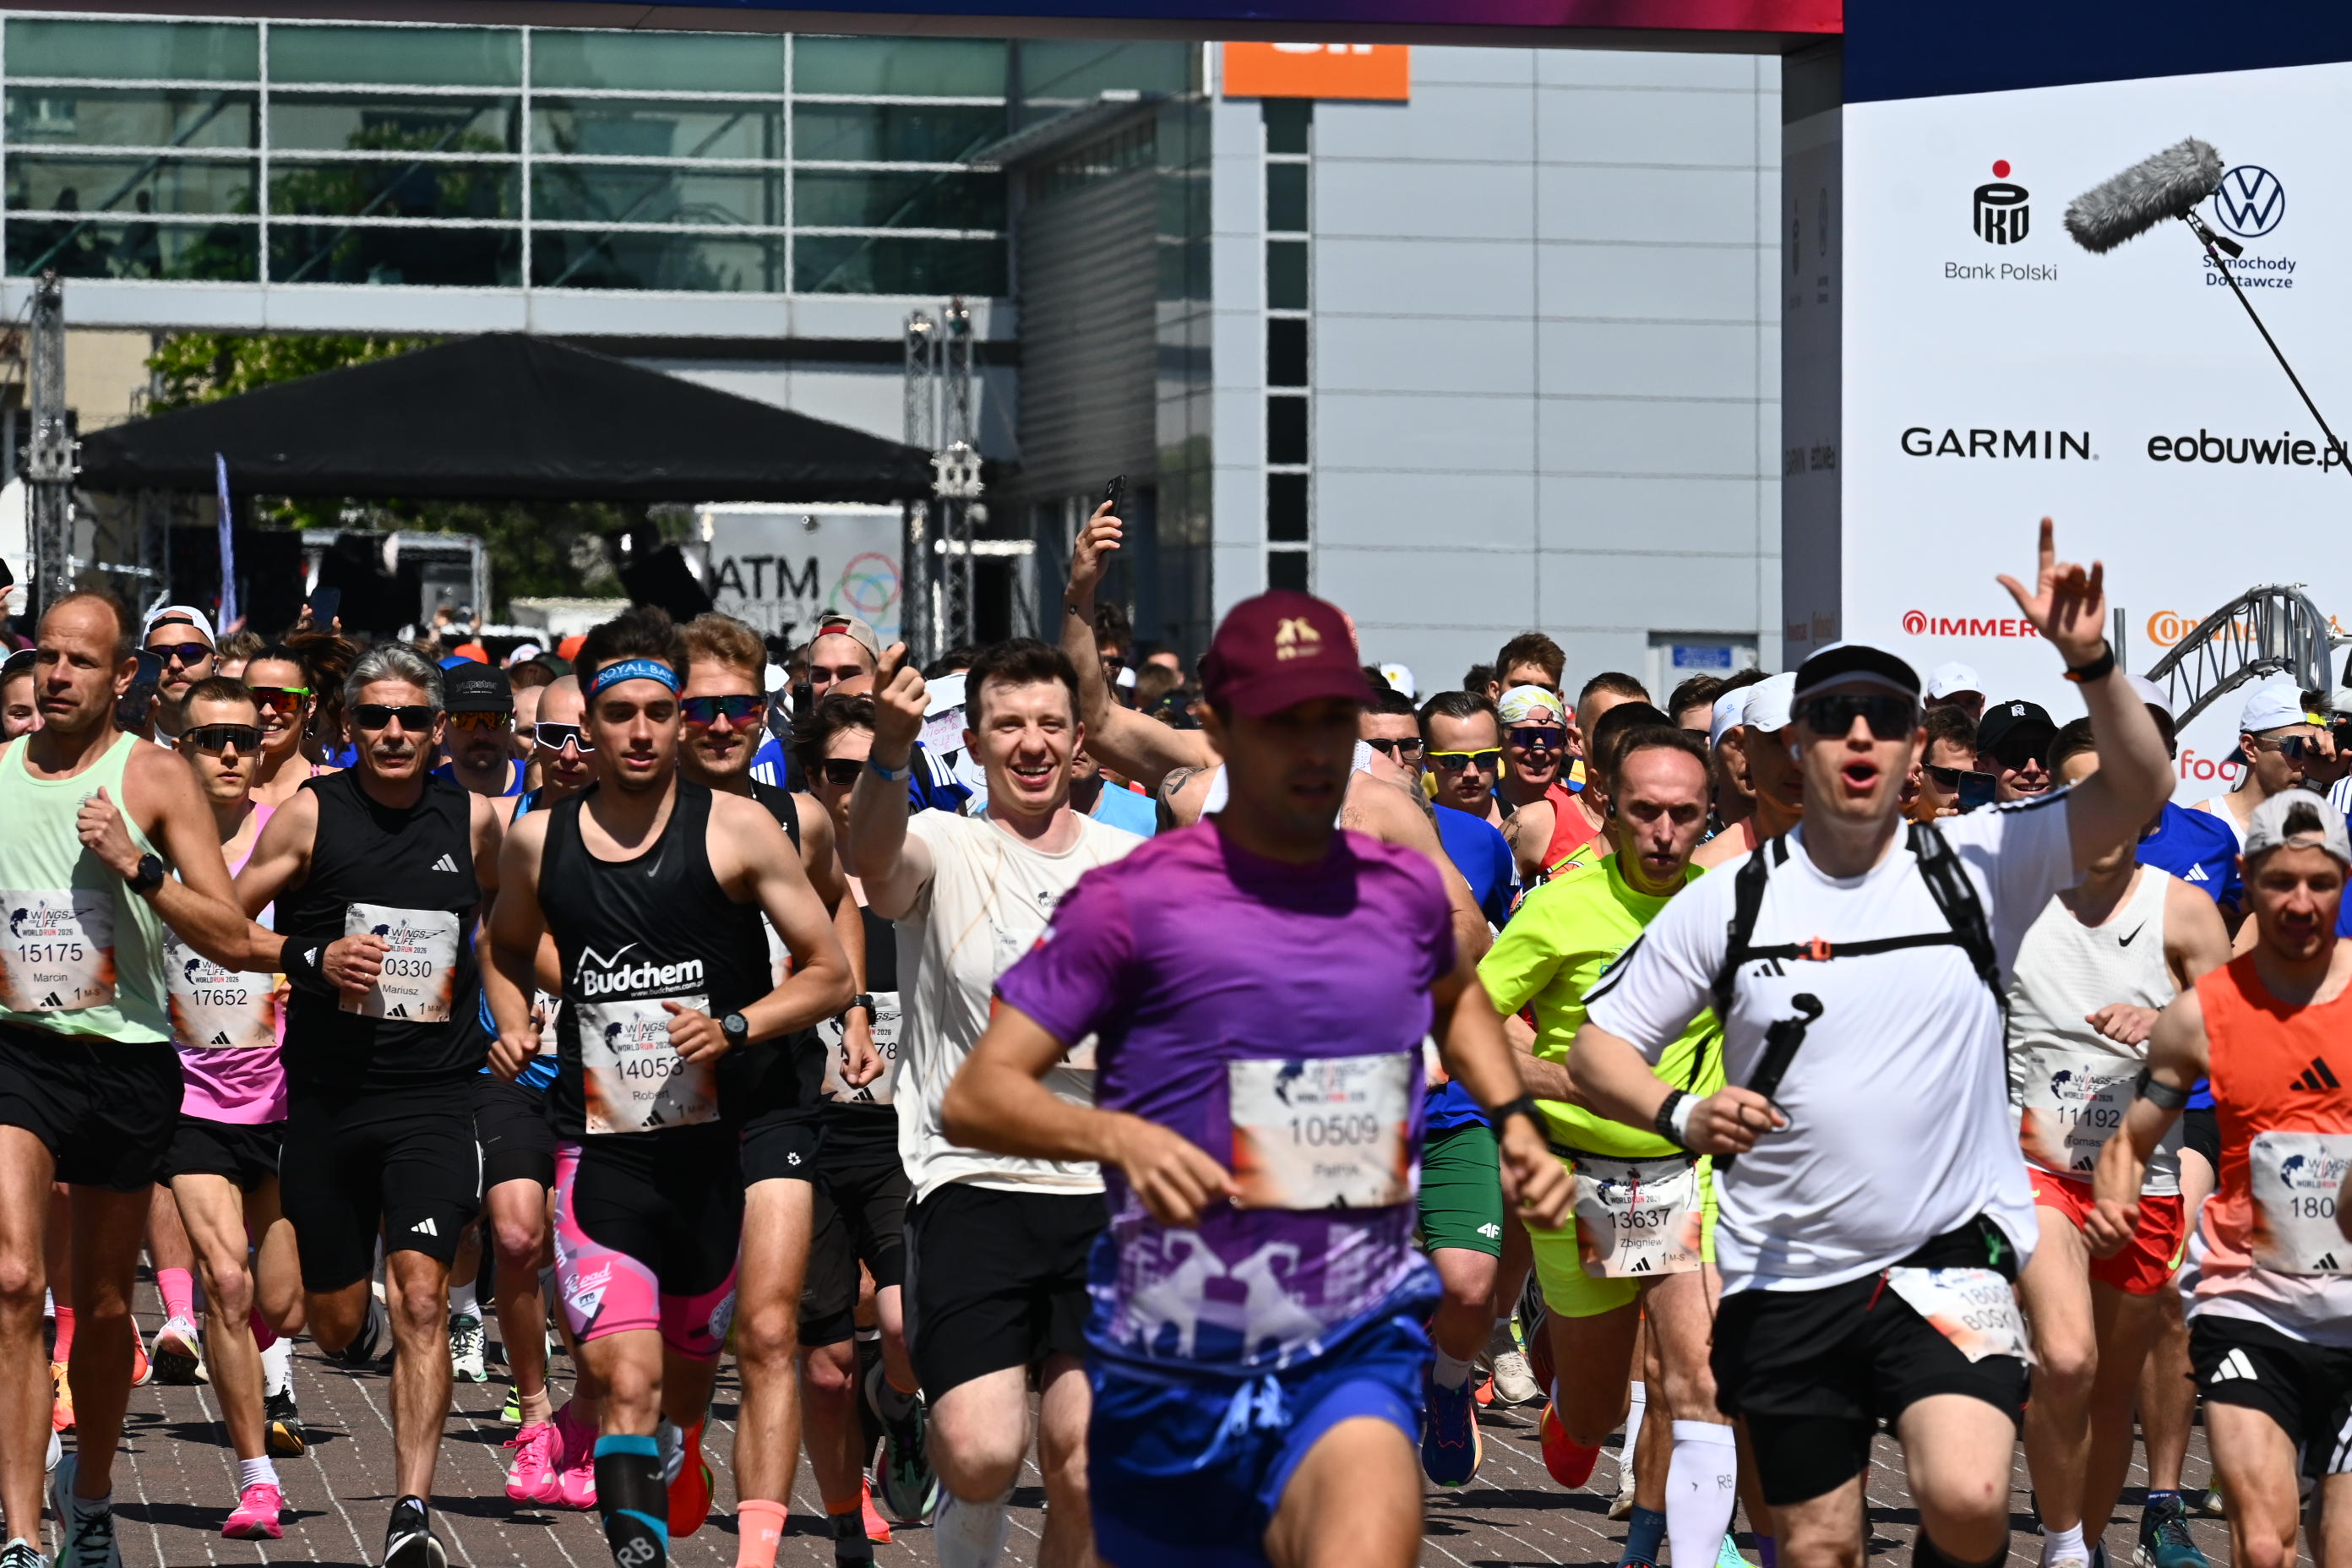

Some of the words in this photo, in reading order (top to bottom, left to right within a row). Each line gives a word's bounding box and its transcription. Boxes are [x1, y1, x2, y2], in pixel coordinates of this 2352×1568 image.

[1945, 262, 1995, 280] Bank
[2001, 263, 2058, 281] Polski
[2206, 273, 2293, 288] Dotawcze
[1901, 427, 2089, 460] GARMIN
[716, 553, 820, 600] ATM
[597, 662, 645, 683] ROYAL
[650, 665, 674, 681] BAY
[30, 909, 69, 920] WINGS
[35, 919, 57, 928] LIFE
[391, 928, 426, 939] WINGS
[19, 943, 83, 962] 15175
[385, 959, 432, 978] 0330
[34, 973, 68, 983] Marcin
[583, 959, 704, 996] Budchem
[74, 988, 80, 1000] 1
[192, 988, 248, 1006] 17652
[382, 984, 419, 996] Mariusz
[419, 1002, 425, 1015] 1
[624, 1021, 666, 1033] WINGS
[631, 1032, 654, 1043] LIFE
[836, 1043, 897, 1059] 178
[2074, 1074, 2111, 1085] WINGS
[632, 1088, 670, 1101] Robert
[2057, 1106, 2121, 1128] 11192
[1289, 1114, 1380, 1146] 10509
[2066, 1135, 2104, 1148] Tomas
[2290, 1196, 2335, 1218] 180
[1608, 1208, 1671, 1228] 13637
[1478, 1222, 1500, 1239] 4F
[1620, 1239, 1663, 1250] Zbigniew
[1661, 1252, 1667, 1266] 1
[617, 1537, 656, 1568] RB
